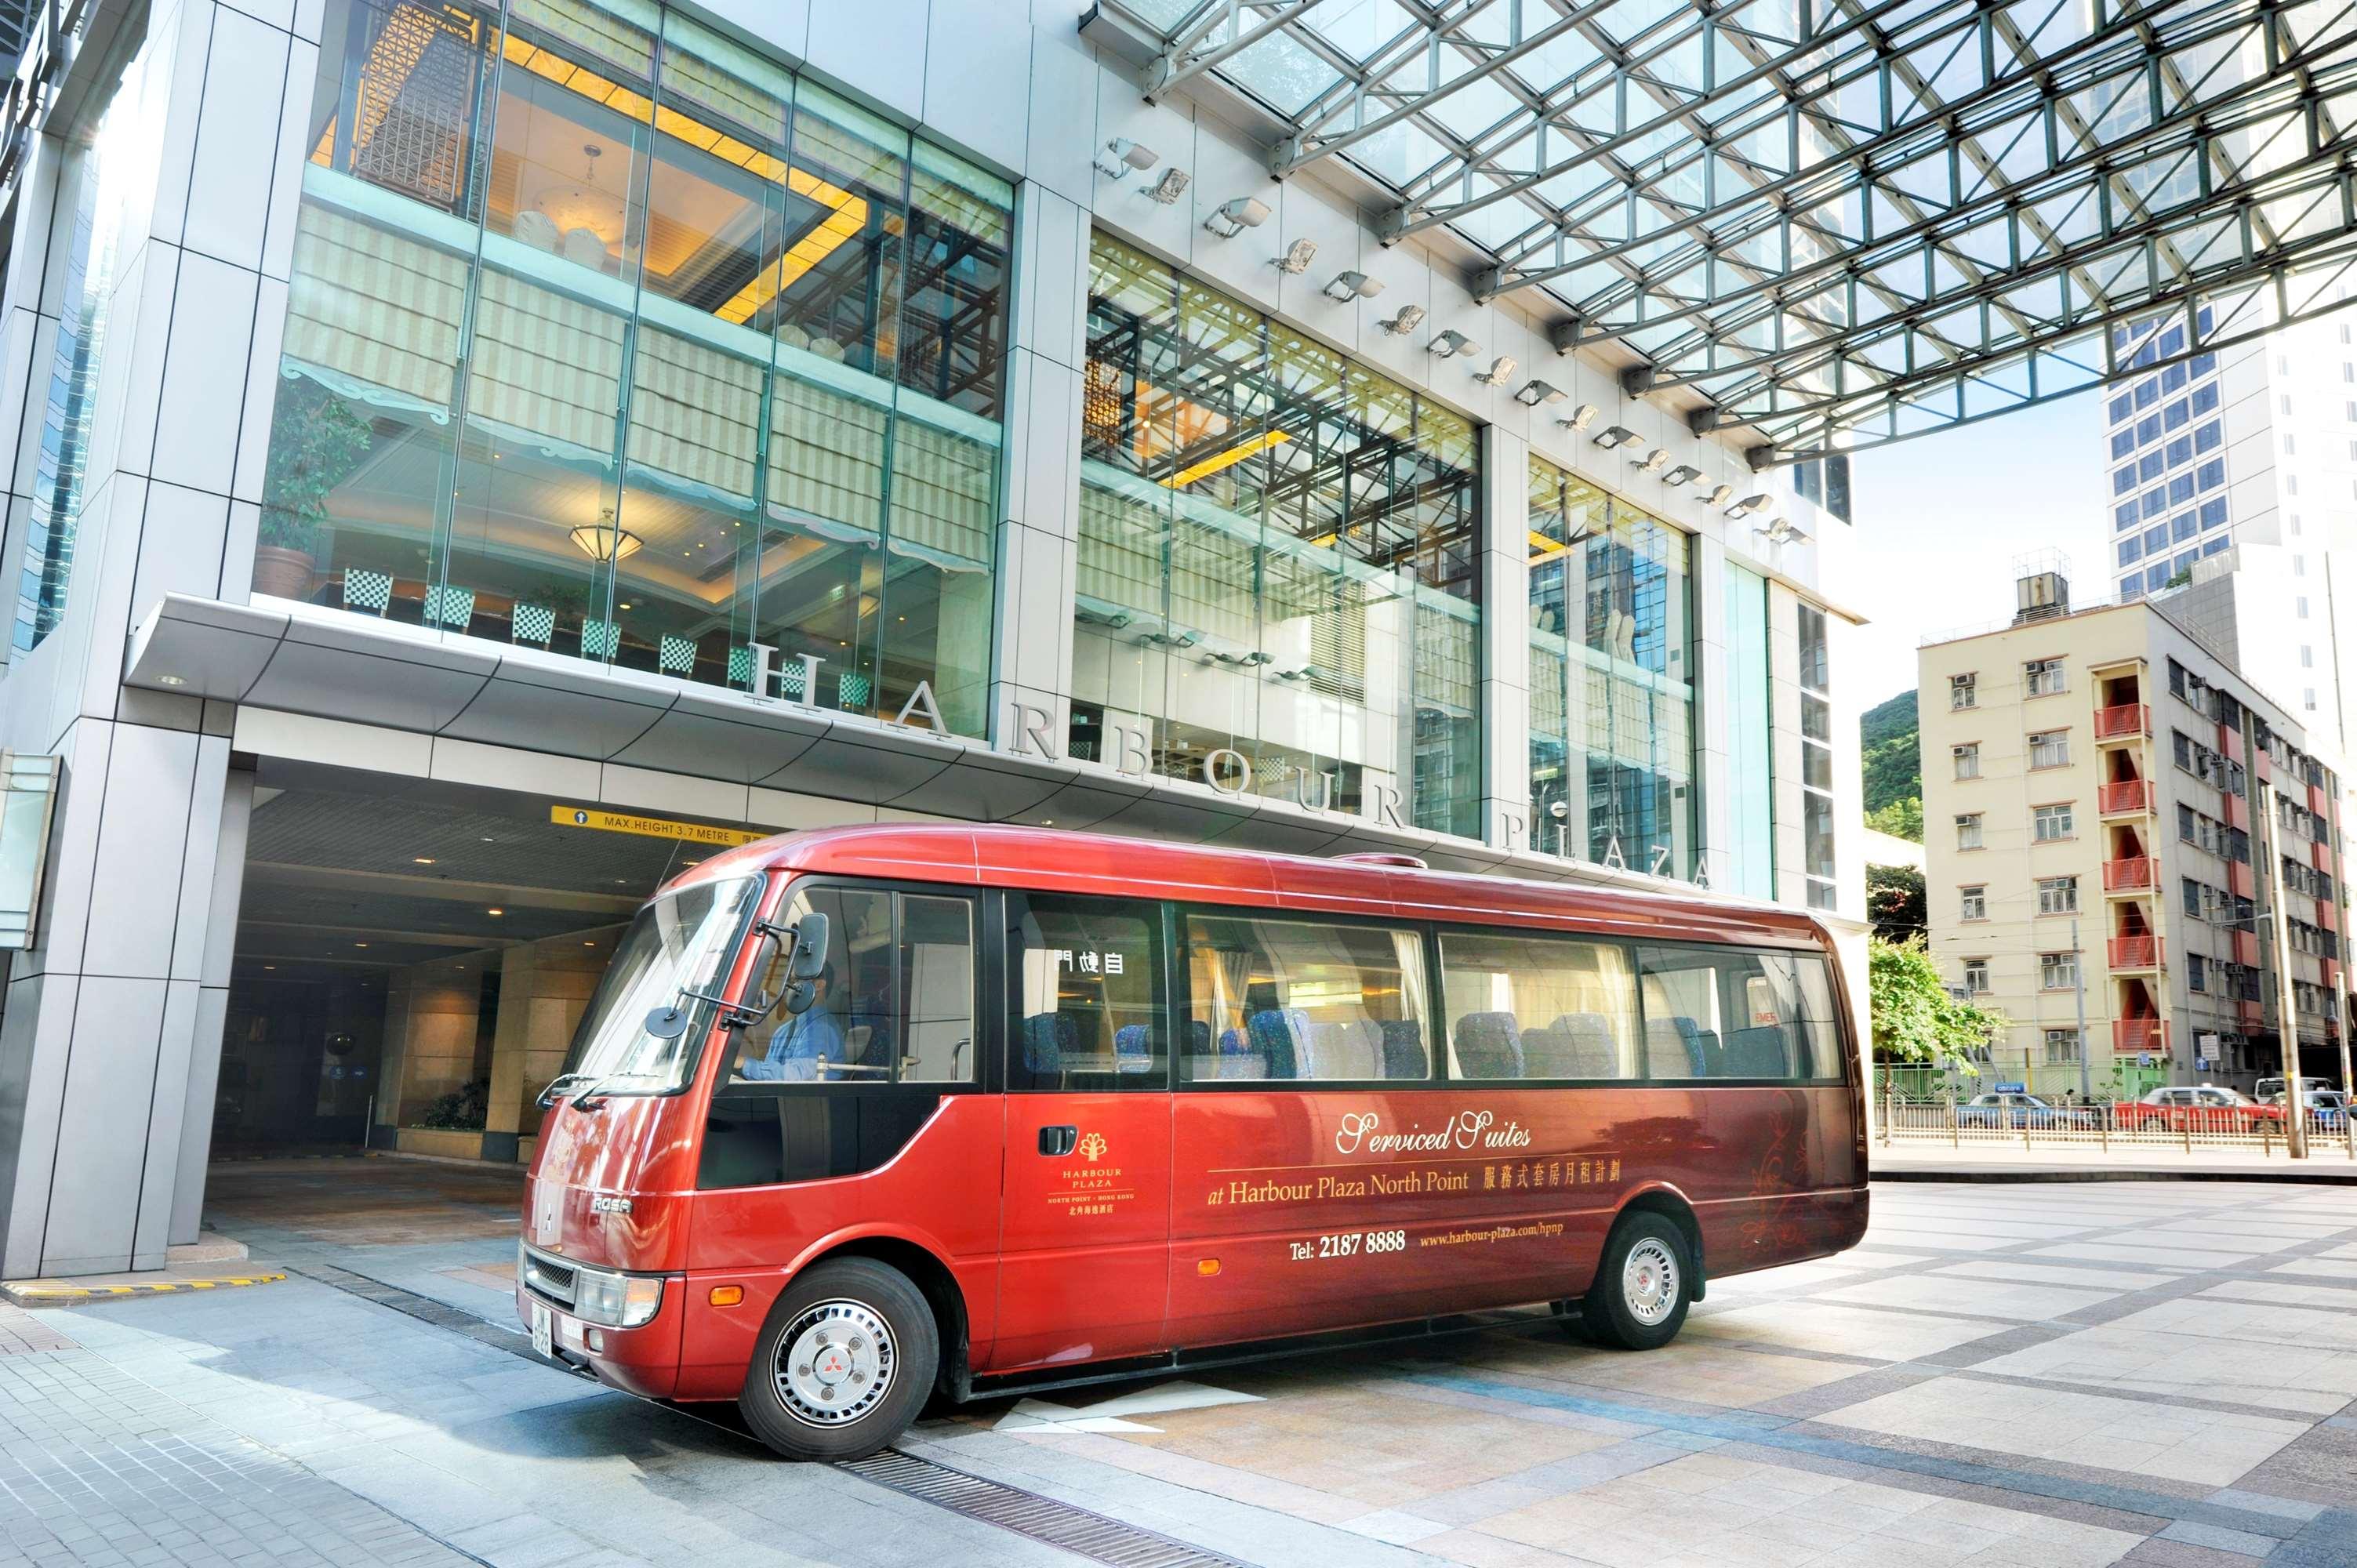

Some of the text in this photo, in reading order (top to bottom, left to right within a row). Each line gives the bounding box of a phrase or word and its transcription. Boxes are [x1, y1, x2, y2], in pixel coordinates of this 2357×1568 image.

[746, 641, 1714, 891] HARBOUR PLAZA
[677, 825, 694, 837] 3.7
[696, 829, 730, 842] METRE
[1335, 1110, 1531, 1154] Serviced Suites
[1062, 1168, 1122, 1178] HARBOUR
[1072, 1179, 1112, 1189] PLAZA
[1208, 1159, 1621, 1205] at Harbour Plaza North Point 服務式套房月租計劃
[594, 1197, 633, 1214] ROSA
[1290, 1221, 1563, 1260] Tel: 2187 8888 www.harbour-plaza.com/hpnp
